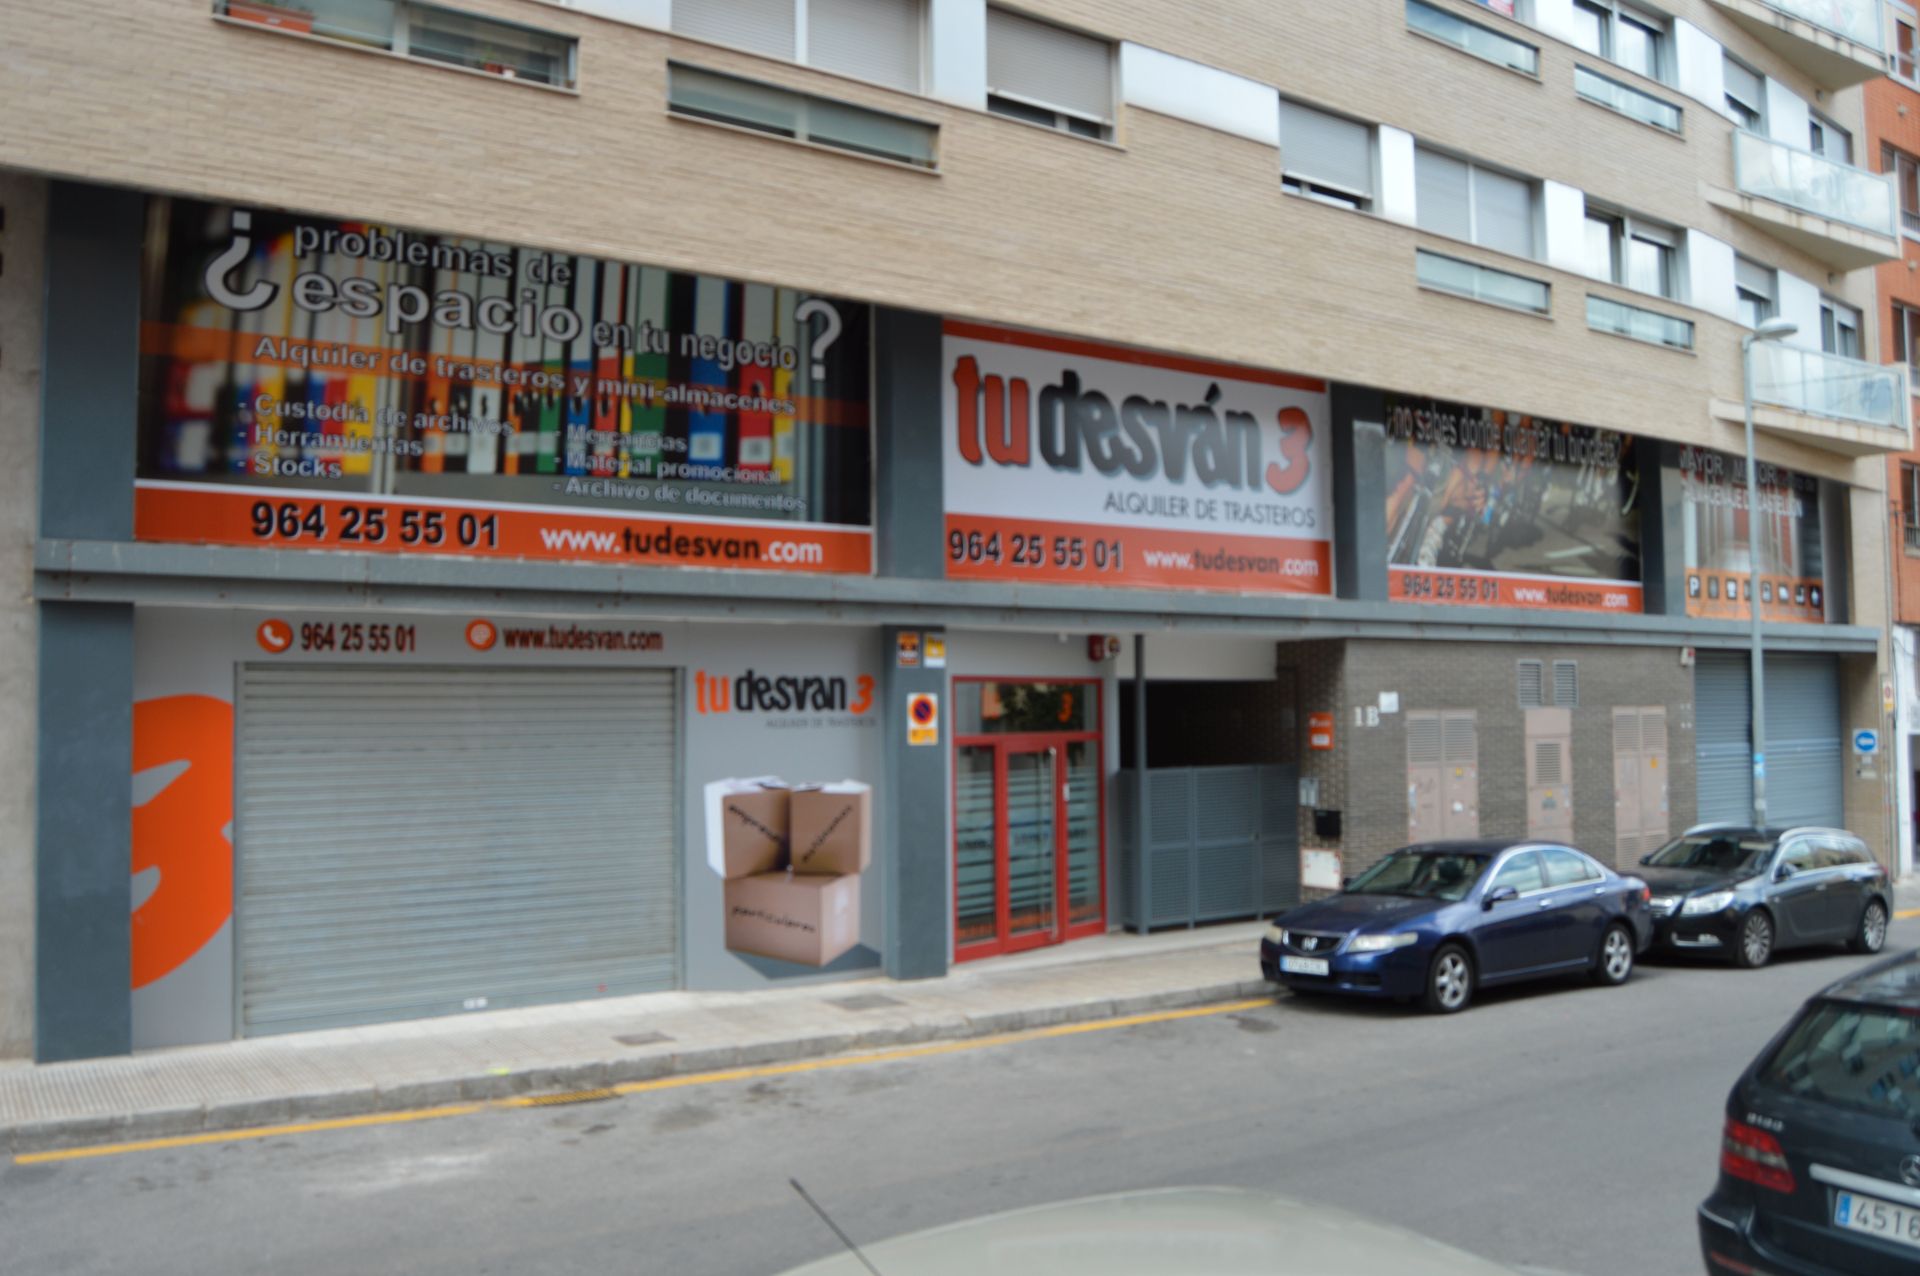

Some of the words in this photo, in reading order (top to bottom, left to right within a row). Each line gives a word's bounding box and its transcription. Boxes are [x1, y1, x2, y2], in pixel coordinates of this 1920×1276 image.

[294, 225, 513, 277] problemas
[525, 253, 572, 286] de
[293, 271, 581, 342] espacio
[593, 320, 630, 349] en
[640, 319, 671, 354] tu
[681, 334, 798, 371] negocio
[254, 336, 382, 371] Alquiler
[389, 351, 427, 375] de
[436, 355, 565, 390] trasteros
[573, 377, 589, 396] y
[597, 377, 797, 415] mini-almacenes
[254, 394, 370, 424] Custodia
[376, 407, 408, 427] de
[413, 413, 515, 436] archivos
[254, 424, 426, 457] Herramientas
[254, 452, 343, 480] Stocks
[566, 449, 651, 475] Material
[656, 460, 782, 486] promocional
[565, 477, 649, 502] Archivo
[655, 484, 680, 503] de
[685, 486, 807, 513] documentos
[1104, 491, 1189, 520] ALQUILER
[1194, 499, 1218, 521] DE
[1222, 501, 1316, 528] TRASTEROS
[251, 501, 327, 540] 964
[340, 507, 387, 542] 25
[399, 510, 447, 545] 55
[458, 513, 499, 549] 01
[540, 526, 824, 564] www.tudesvan.com
[949, 529, 1002, 565] 964
[1011, 534, 1046, 568] 25
[1053, 536, 1086, 569] 55
[1094, 539, 1124, 572] 01
[1143, 545, 1319, 577] www.tudesvan.com
[1403, 575, 1432, 597] 964
[1437, 577, 1455, 598] 25
[1459, 578, 1478, 599] 55
[1482, 579, 1500, 600] 01
[1513, 584, 1629, 608] www.tudesvan.com
[301, 623, 336, 651] 964
[341, 624, 366, 651] 25
[368, 625, 391, 652] 55
[395, 625, 416, 652] 01
[503, 625, 663, 651] www.tudesvan.com
[1855, 1201, 1920, 1241] 4516
